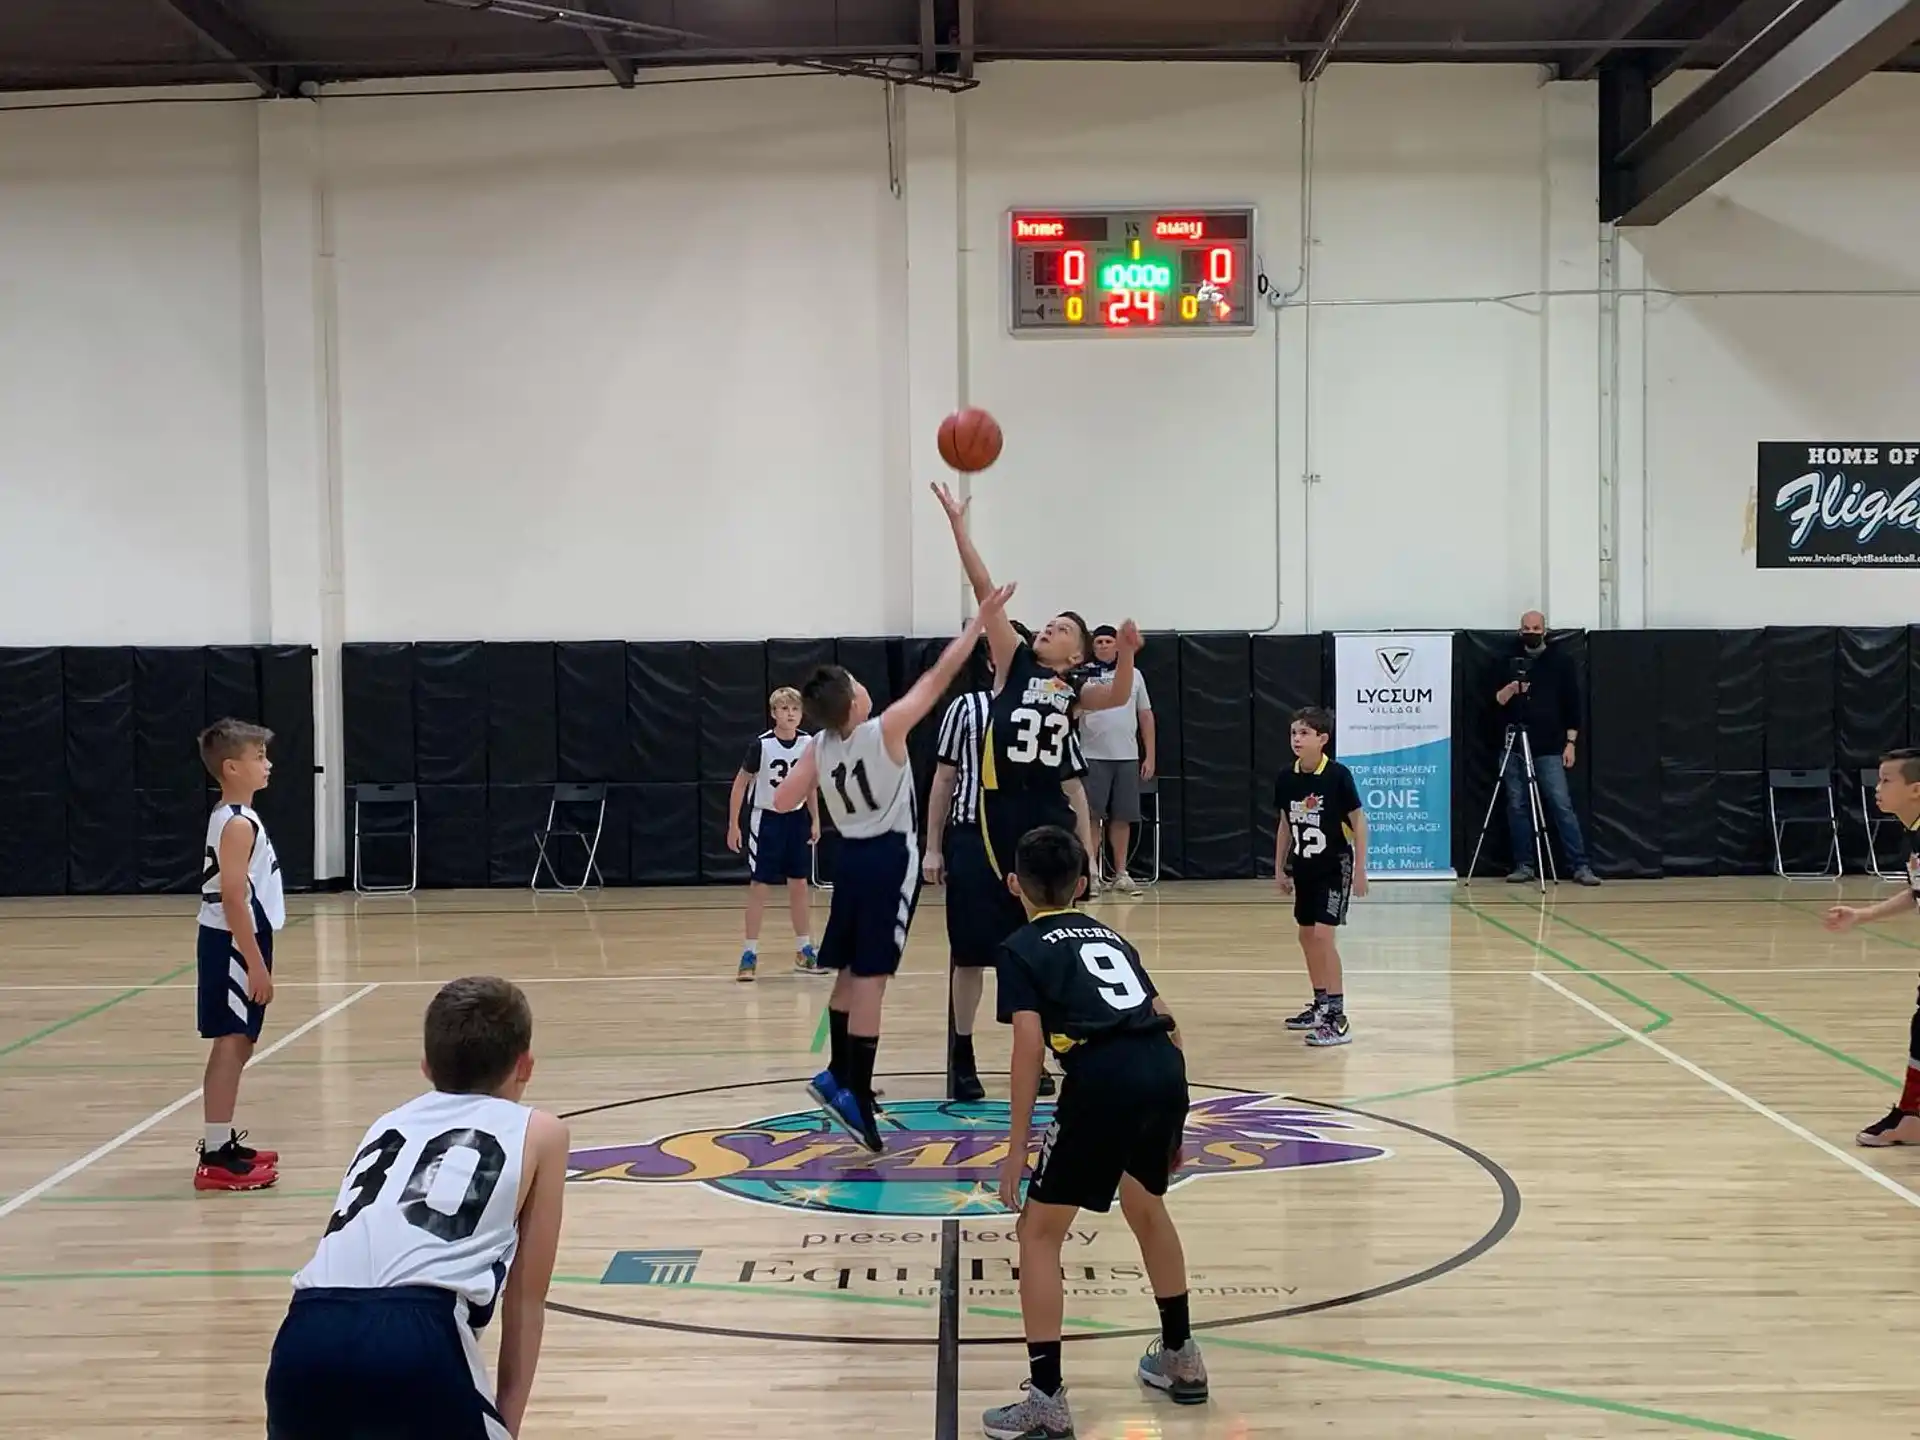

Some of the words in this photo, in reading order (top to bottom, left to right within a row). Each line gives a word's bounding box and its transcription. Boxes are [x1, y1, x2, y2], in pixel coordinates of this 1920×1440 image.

[1016, 219, 1064, 237] home
[1155, 220, 1203, 240] away
[1063, 249, 1085, 286] 0
[1209, 248, 1233, 284] 0
[1066, 296, 1083, 321] 0
[1109, 289, 1156, 324] 24
[1181, 294, 1198, 320] 0
[1807, 447, 1879, 465] HOME
[1888, 447, 1920, 465] OF
[1775, 472, 1920, 545] Fligh
[1006, 707, 1070, 767] 33
[769, 758, 800, 788] 3
[1361, 777, 1412, 787] ACTIVITIES
[1414, 777, 1425, 786] IN
[1372, 765, 1438, 775] ENRICHMENT
[830, 758, 881, 814] 11
[1367, 789, 1420, 809] ONE
[1363, 811, 1404, 821] XCITING
[1406, 811, 1429, 820] AND
[1366, 823, 1404, 833] TURING
[1291, 823, 1327, 859] 12
[1367, 843, 1423, 855] cademics
[1364, 859, 1384, 869] rts
[1386, 858, 1397, 869] &
[1399, 857, 1436, 870] Music
[1078, 941, 1148, 1011] 9
[323, 1127, 508, 1243] 30
[898, 1286, 940, 1296] Lif
[1140, 1285, 1299, 1296] Cmpany
